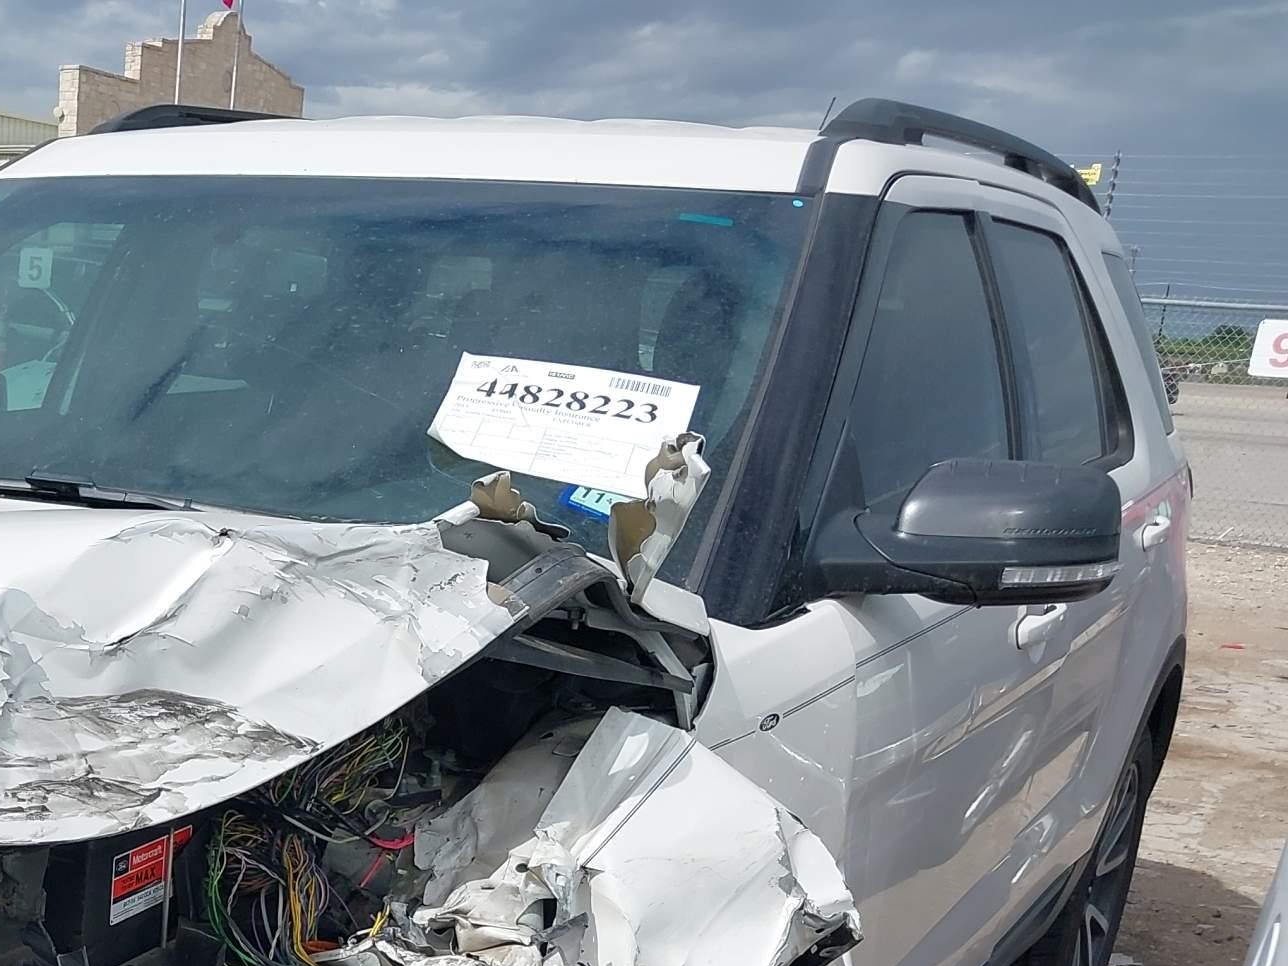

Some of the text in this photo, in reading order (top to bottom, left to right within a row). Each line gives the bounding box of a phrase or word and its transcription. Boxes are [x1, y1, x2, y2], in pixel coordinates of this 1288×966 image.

[27, 256, 43, 282] 5
[475, 378, 659, 423] 44828223
[132, 845, 163, 865] Motorcraft
[135, 867, 157, 885] MAX
